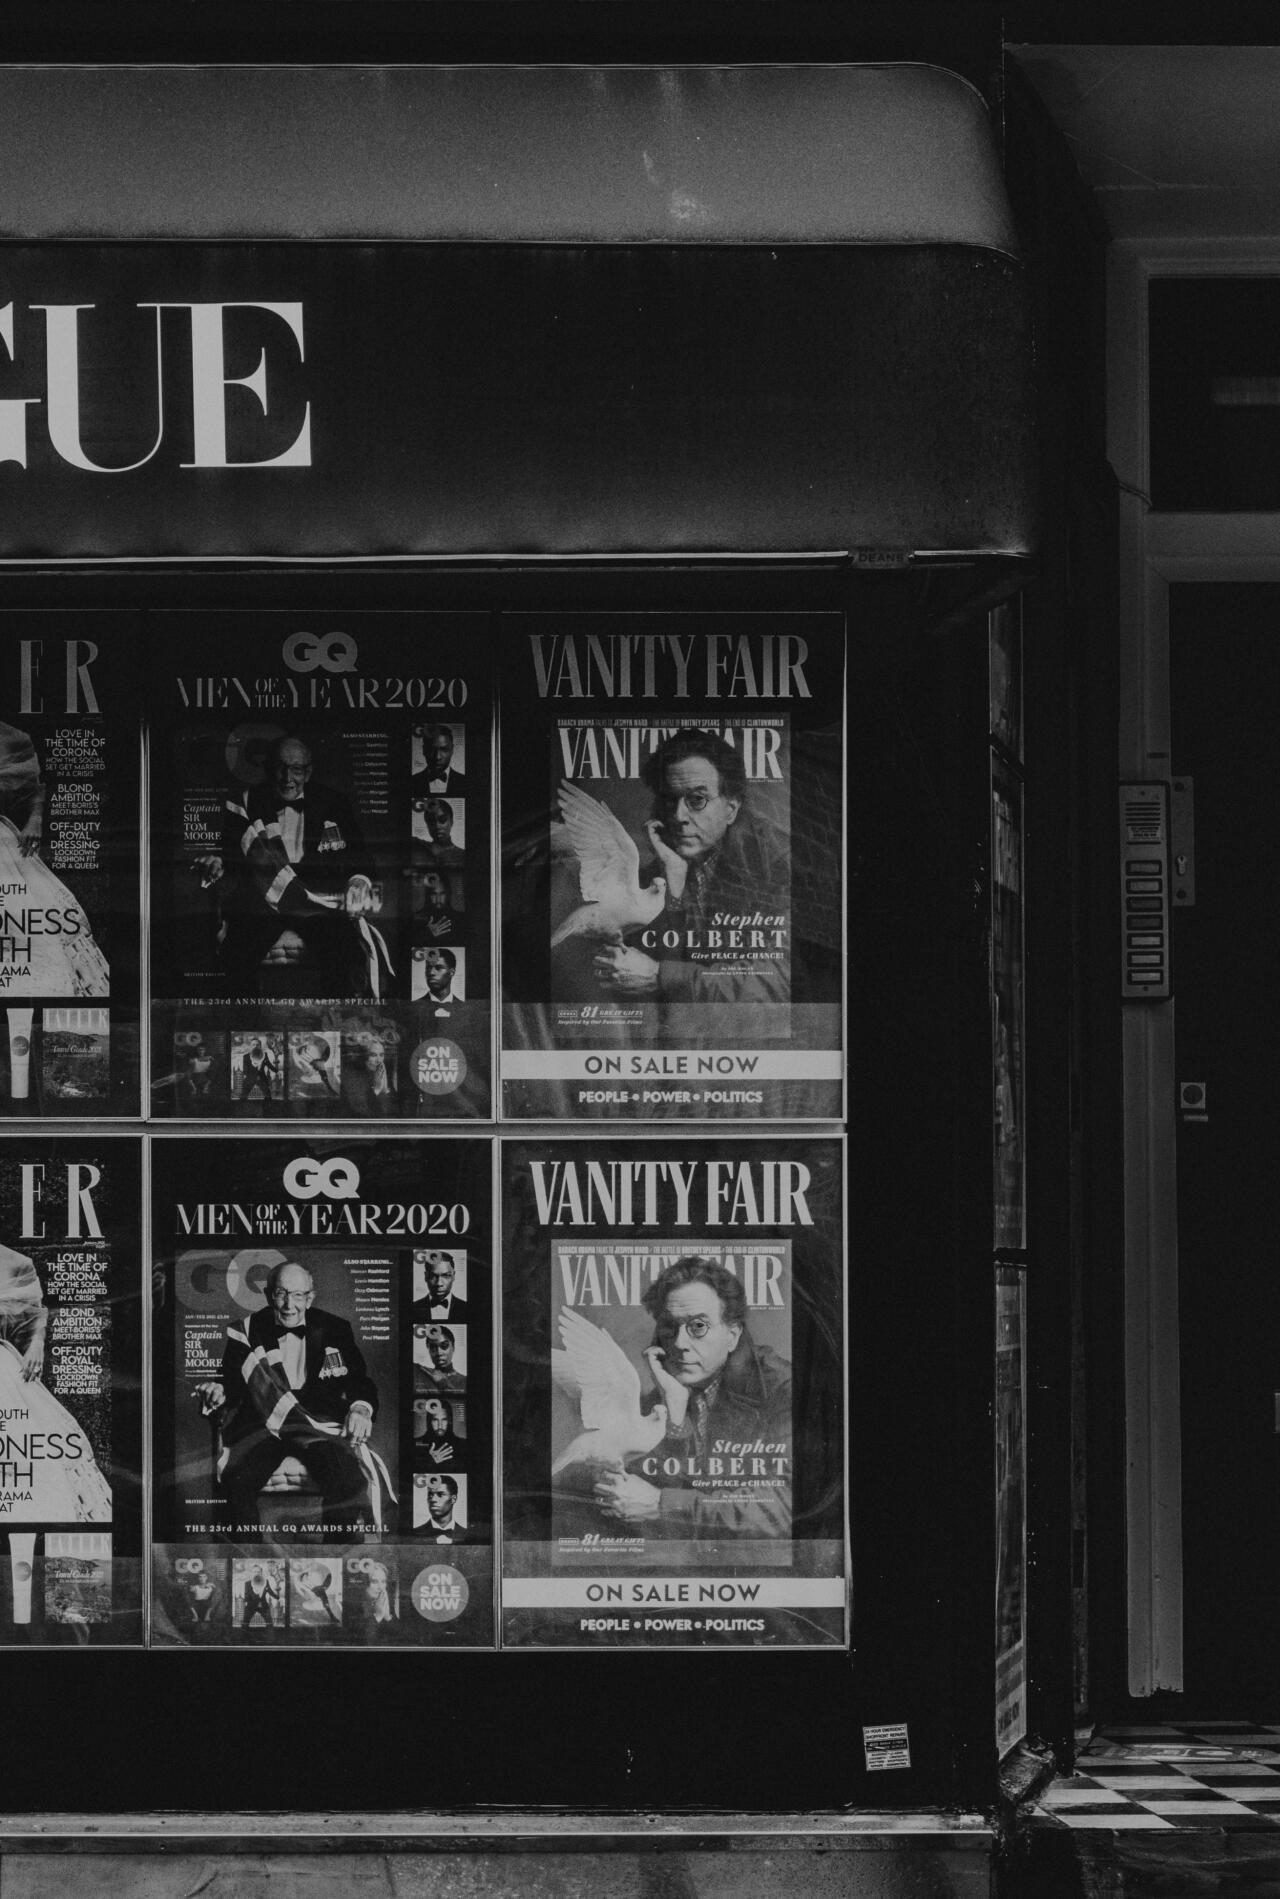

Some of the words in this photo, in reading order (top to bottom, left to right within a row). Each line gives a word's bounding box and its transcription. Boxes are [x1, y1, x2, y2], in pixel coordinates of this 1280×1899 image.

[282, 631, 358, 673] GQ
[528, 634, 696, 698] VANITY
[704, 634, 813, 698] FAIR
[176, 677, 252, 708] MEN
[255, 678, 279, 693] OF
[286, 677, 380, 708] YEAR
[384, 677, 468, 708] 2020
[255, 694, 286, 708] THE
[711, 911, 785, 929] Stephen
[641, 930, 787, 948] COLBERT
[584, 1056, 621, 1074] ON
[631, 1056, 688, 1074] SALE
[698, 1056, 759, 1074] NOW
[282, 1157, 360, 1200] GQ
[528, 1161, 698, 1225] VANITY
[705, 1161, 815, 1225] FAIR
[176, 1204, 254, 1234] MEN
[256, 1204, 280, 1219] OF
[287, 1204, 383, 1234] YEAR
[386, 1204, 470, 1234] 2020
[256, 1221, 287, 1234] THE
[57, 1253, 83, 1263] LOVE
[86, 1253, 97, 1263] IN
[47, 1262, 66, 1272] THE
[67, 1262, 92, 1272] TIME
[93, 1262, 108, 1272] OF
[54, 1271, 100, 1281] CORONA
[59, 1308, 95, 1317] BLOND
[51, 1317, 102, 1327] AMBITION
[184, 1330, 222, 1341] Captain
[184, 1340, 202, 1349] SIR
[51, 1346, 103, 1356] OFF-DUTY
[184, 1349, 208, 1358] TOM
[60, 1356, 94, 1365] ROYAL
[184, 1358, 223, 1367] MOORE
[52, 1365, 103, 1375] DRESSING
[712, 1439, 787, 1457] Stephen
[642, 1457, 789, 1476] COLBERT
[691, 1479, 711, 1488] Give
[711, 1479, 739, 1487] PEACE
[747, 1479, 785, 1487] CHANGE!
[185, 1524, 206, 1533] THE
[209, 1524, 232, 1533] 23rd
[236, 1524, 279, 1533] ANNUAL
[282, 1524, 297, 1534] GQ
[300, 1524, 343, 1533] AWARDS
[346, 1524, 390, 1533] SPECIAL
[428, 1573, 453, 1585] ON
[419, 1586, 461, 1598] SALE
[585, 1584, 623, 1602] ON
[632, 1584, 689, 1602] SALE
[699, 1584, 761, 1602] NOW
[420, 1598, 460, 1610] NOW
[580, 1619, 629, 1631] PEOPLE
[645, 1619, 692, 1631] POWER
[705, 1619, 765, 1631] POLITICS
